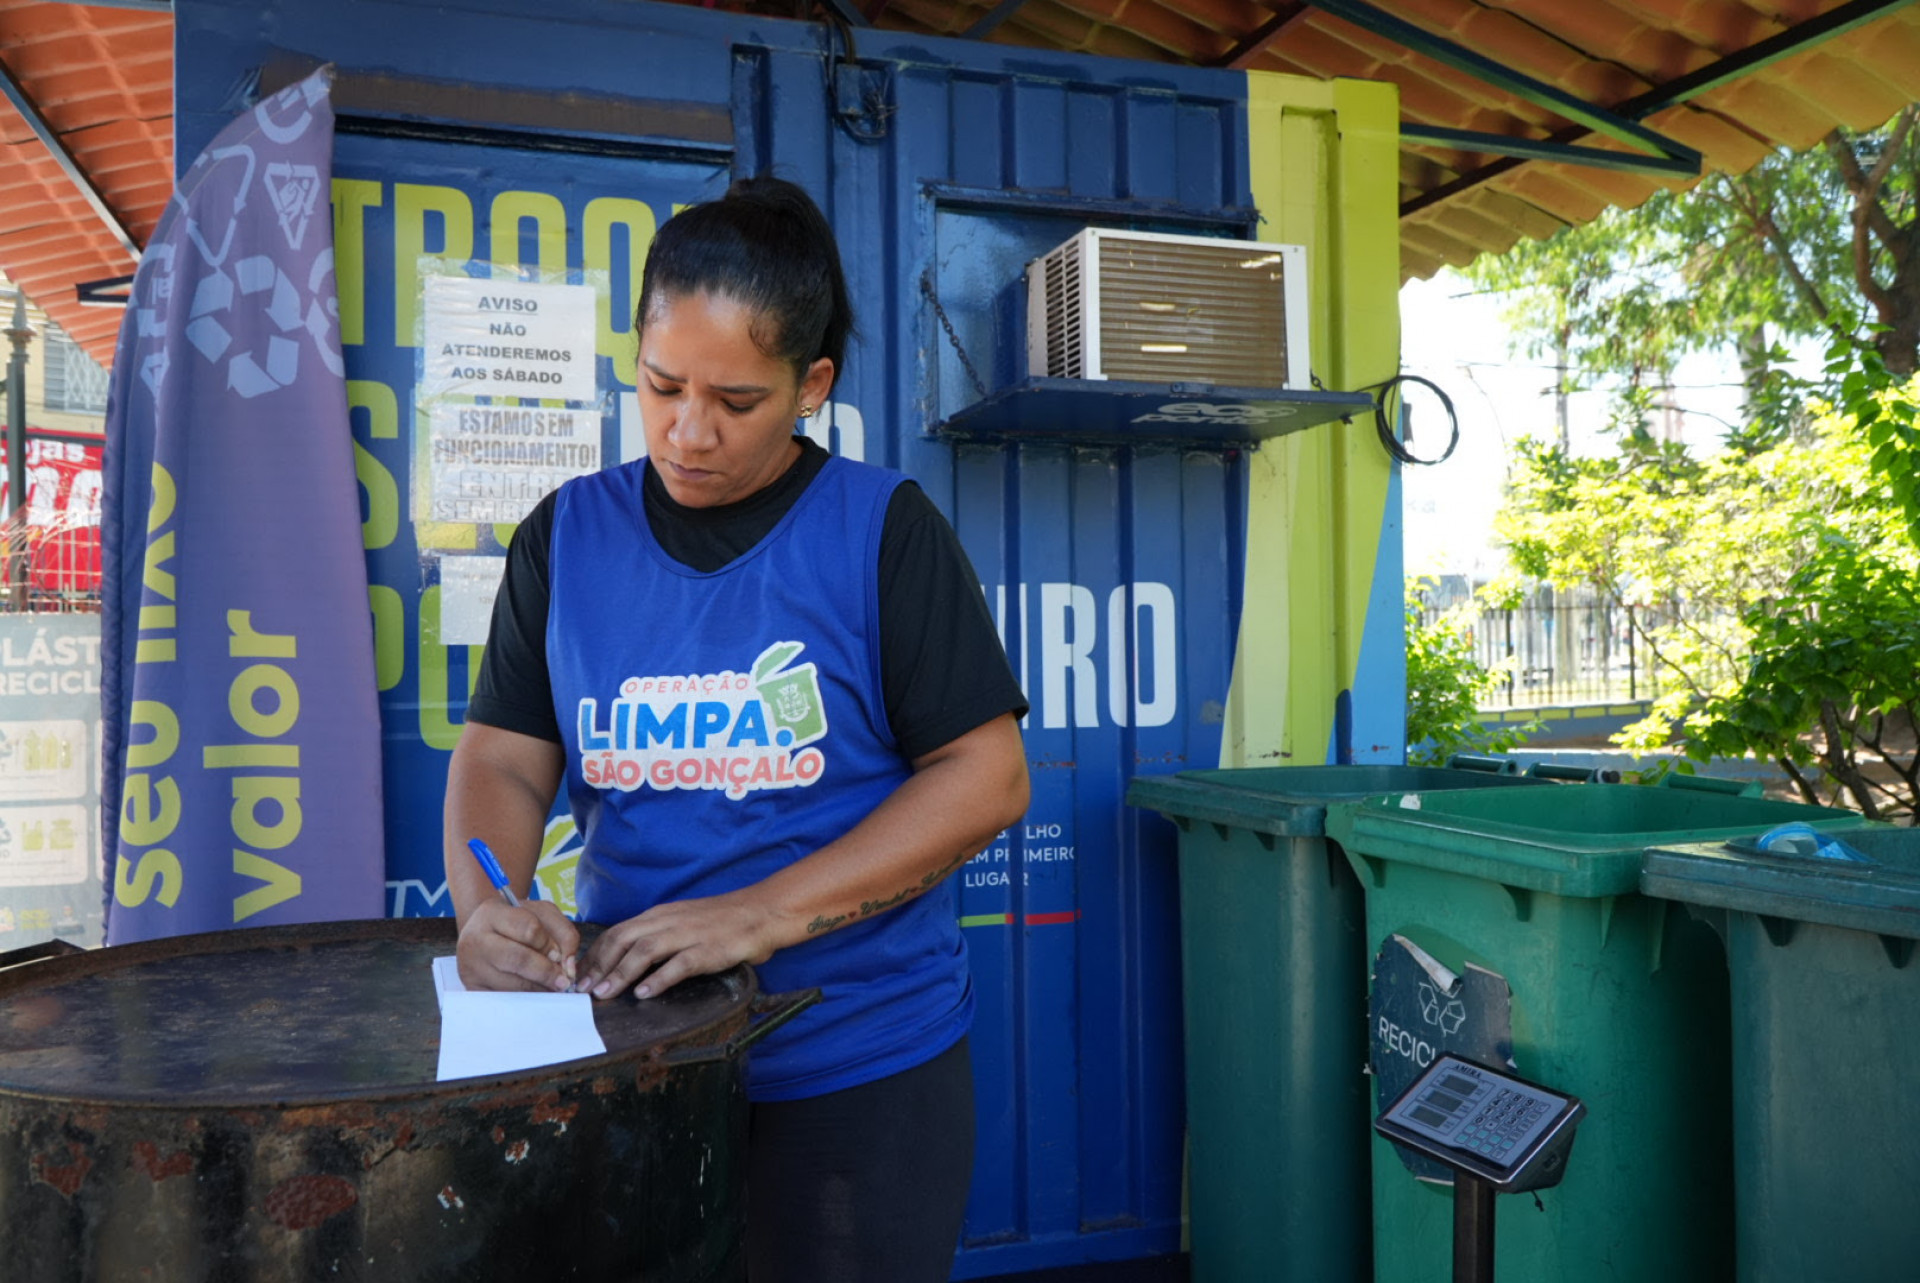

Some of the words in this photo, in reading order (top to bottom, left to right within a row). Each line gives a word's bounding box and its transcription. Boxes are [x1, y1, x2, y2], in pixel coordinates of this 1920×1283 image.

[478, 296, 538, 312] AVISO
[489, 322, 527, 337] NÃO
[442, 343, 572, 362] ATENDEREMOS
[451, 366, 487, 381] AOS
[493, 367, 563, 385] SÁBADO
[459, 409, 545, 437] ESTAMOS
[548, 414, 574, 437] EM
[434, 438, 598, 468] FUNCIONAMENTO!
[625, 675, 748, 695] OPERAÇÃO
[581, 700, 793, 750] LIMPA.
[203, 609, 303, 923] valor
[584, 752, 641, 786] SÃO
[650, 753, 820, 794] GONÇALO
[114, 700, 182, 908] seu
[1453, 1064, 1483, 1078] AMIRA
